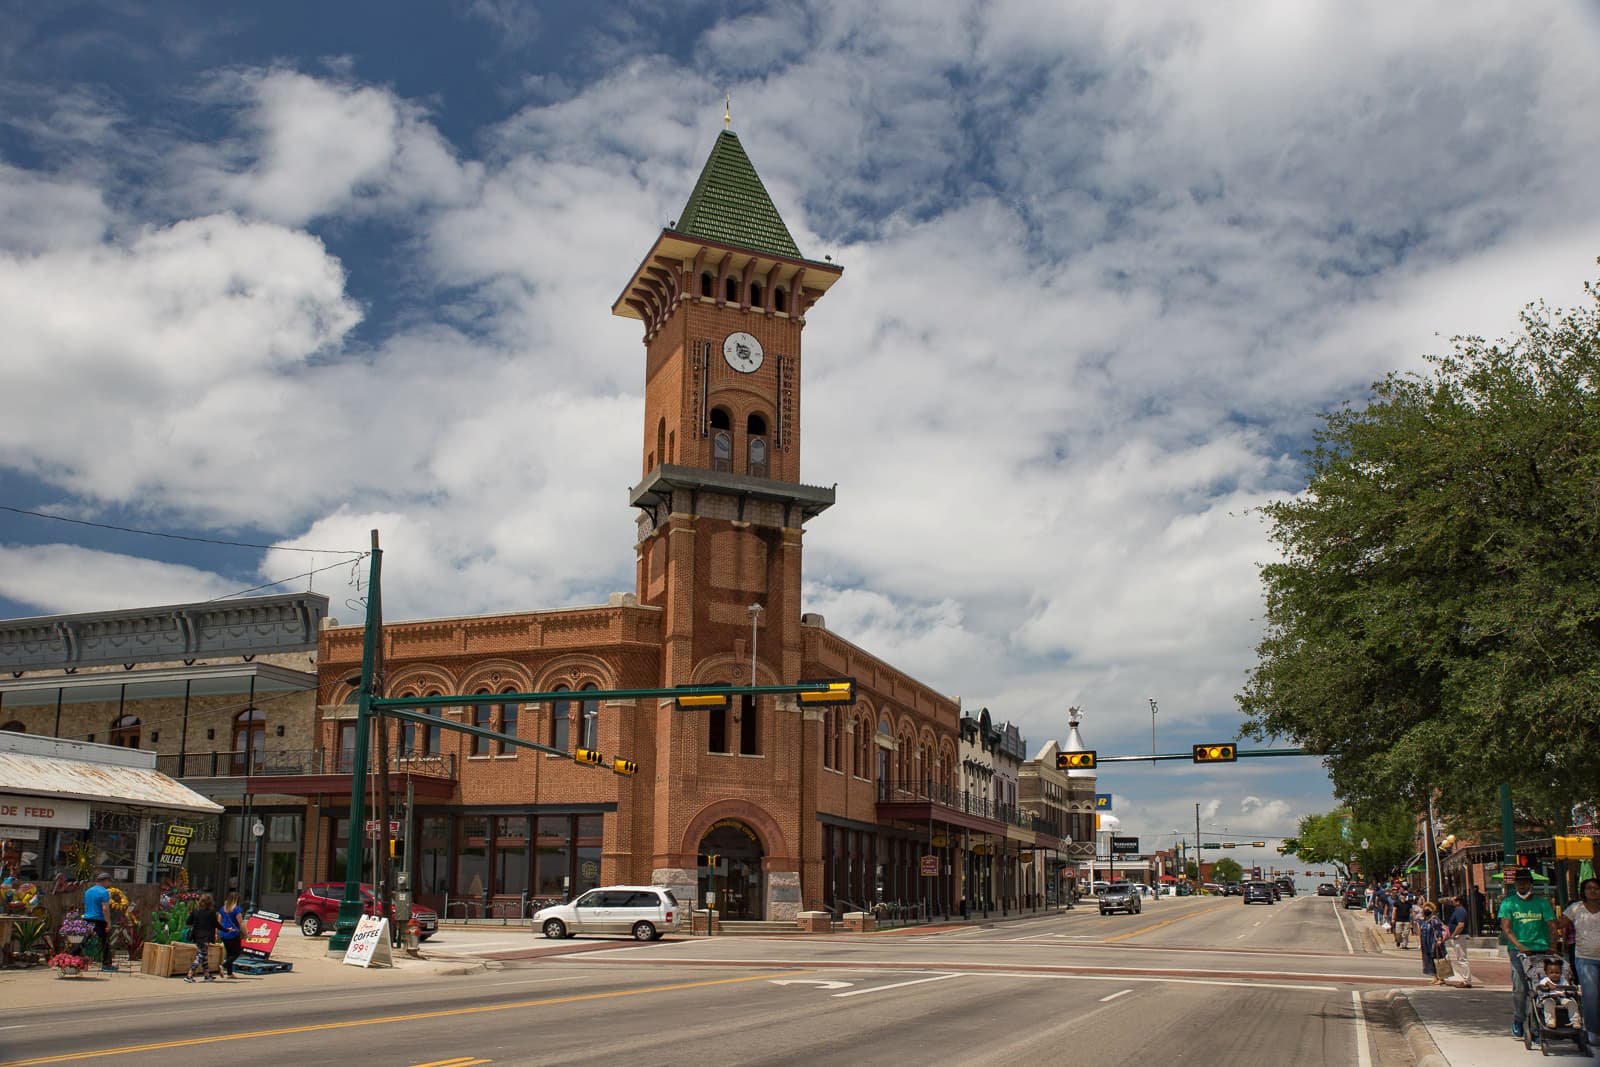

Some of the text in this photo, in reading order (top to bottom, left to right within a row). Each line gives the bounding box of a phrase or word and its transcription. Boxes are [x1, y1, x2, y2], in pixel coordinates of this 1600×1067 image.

[24, 806, 55, 818] FEED
[168, 835, 188, 846] BED
[164, 845, 186, 856] BUG
[159, 854, 184, 865] KILLER
[353, 929, 380, 942] COFFEE
